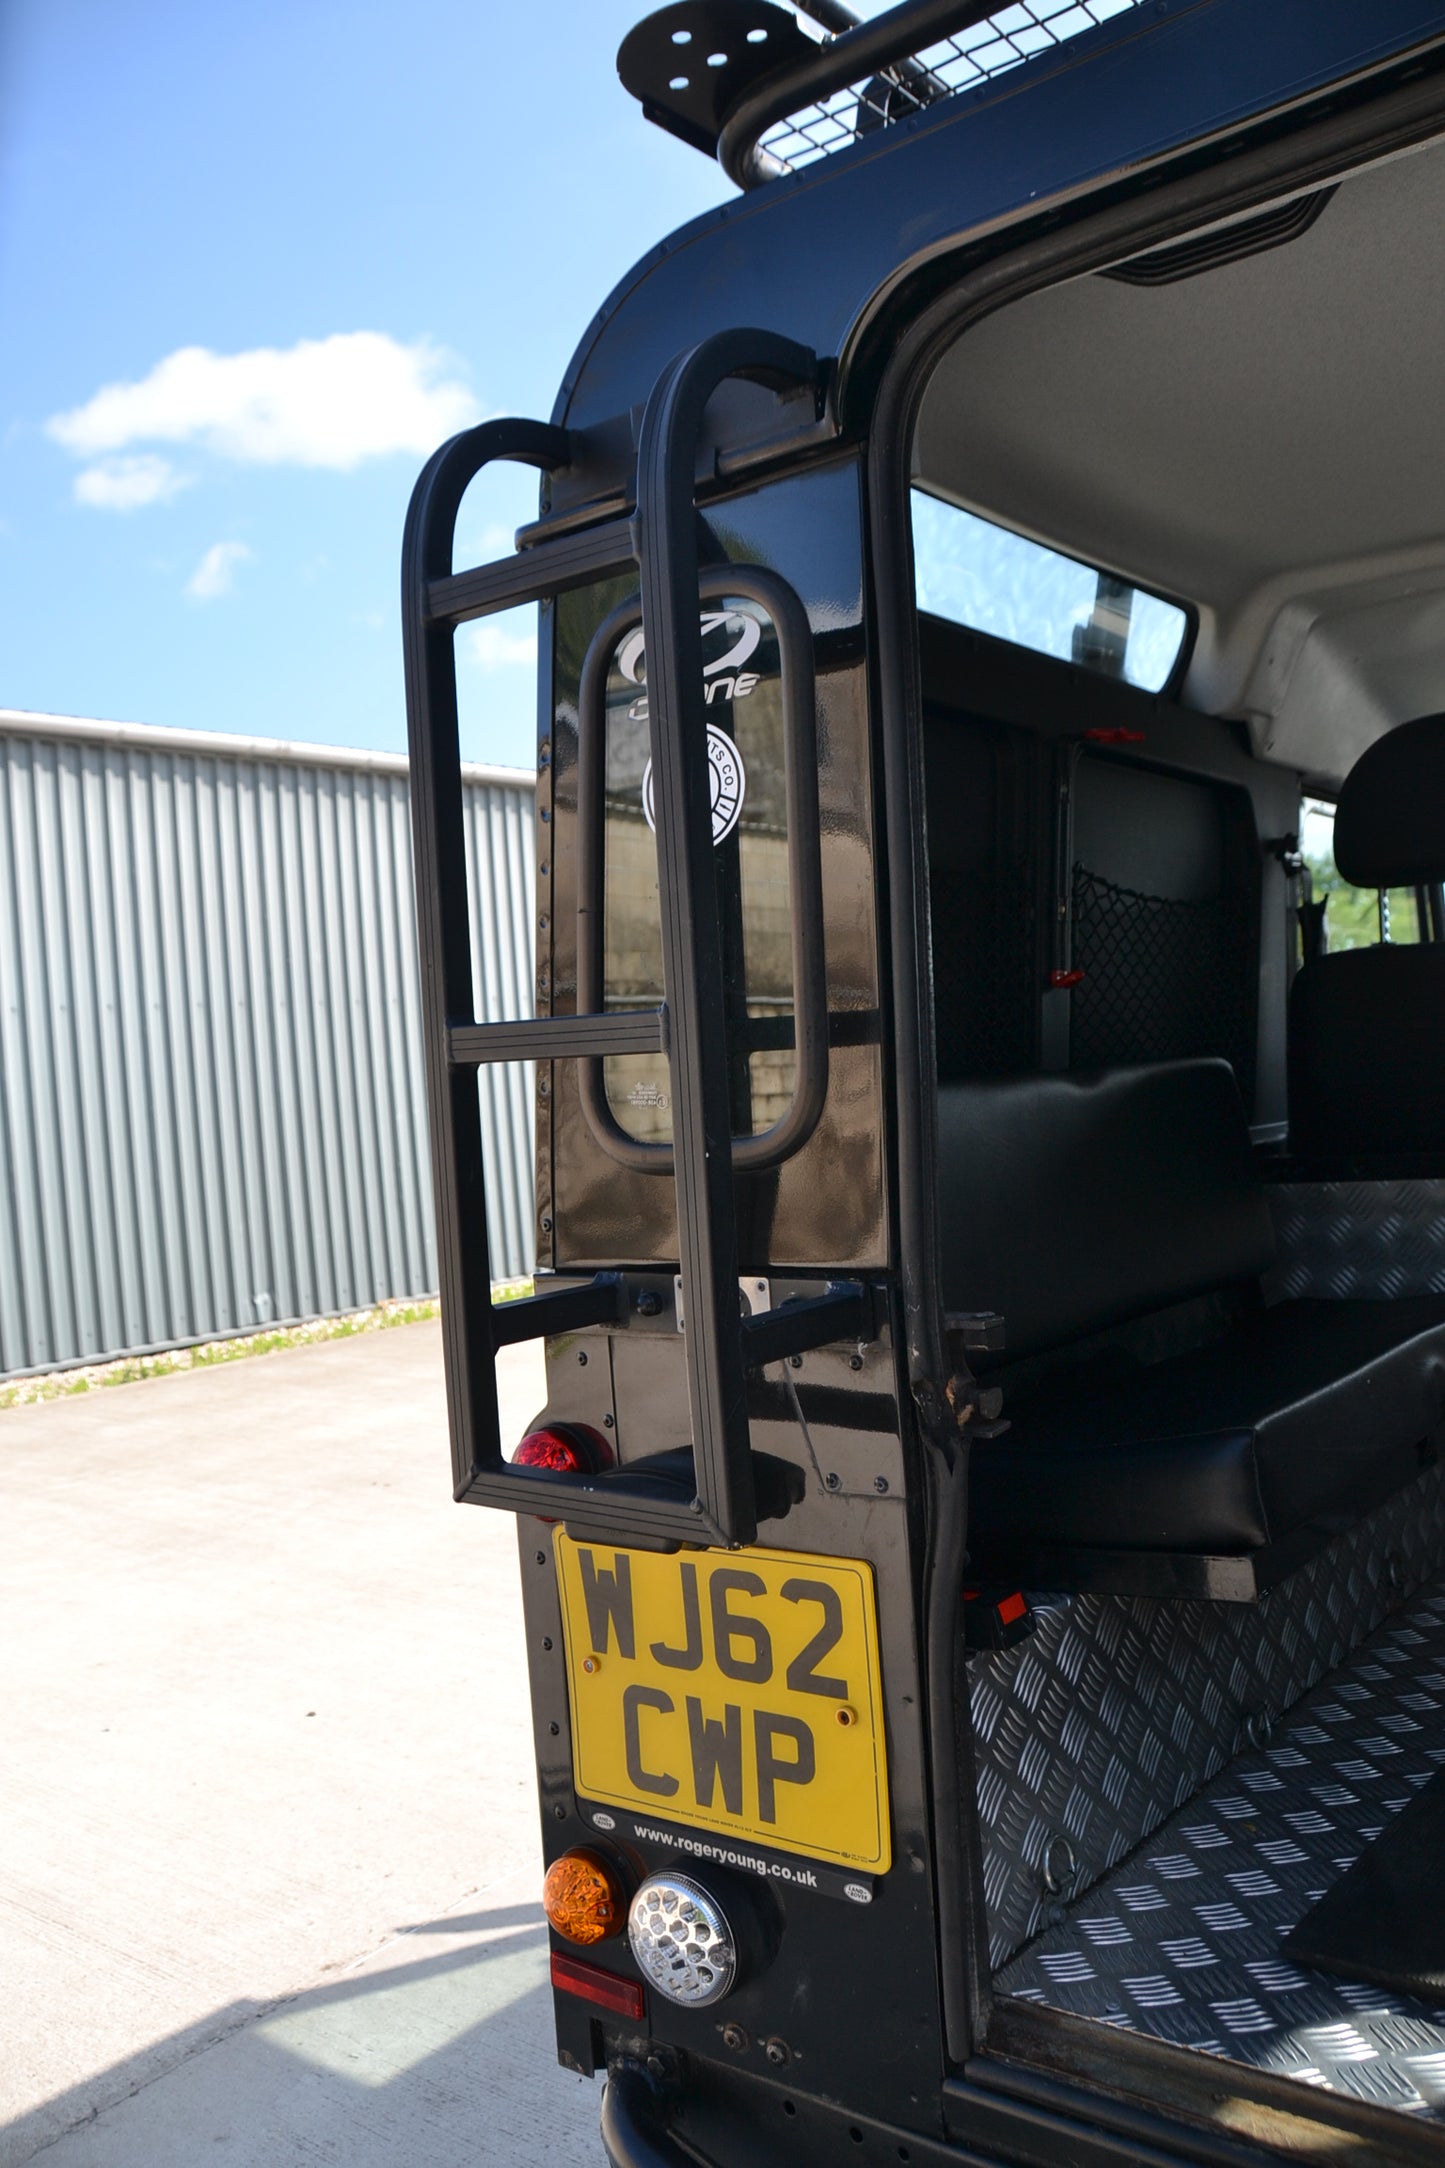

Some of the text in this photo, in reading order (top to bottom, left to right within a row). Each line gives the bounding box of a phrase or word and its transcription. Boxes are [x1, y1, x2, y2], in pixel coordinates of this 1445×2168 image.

[577, 1548, 849, 1700] WJ62
[622, 1684, 816, 1825] CWP
[633, 1824, 818, 1889] www.rogeryoung.co.uk
